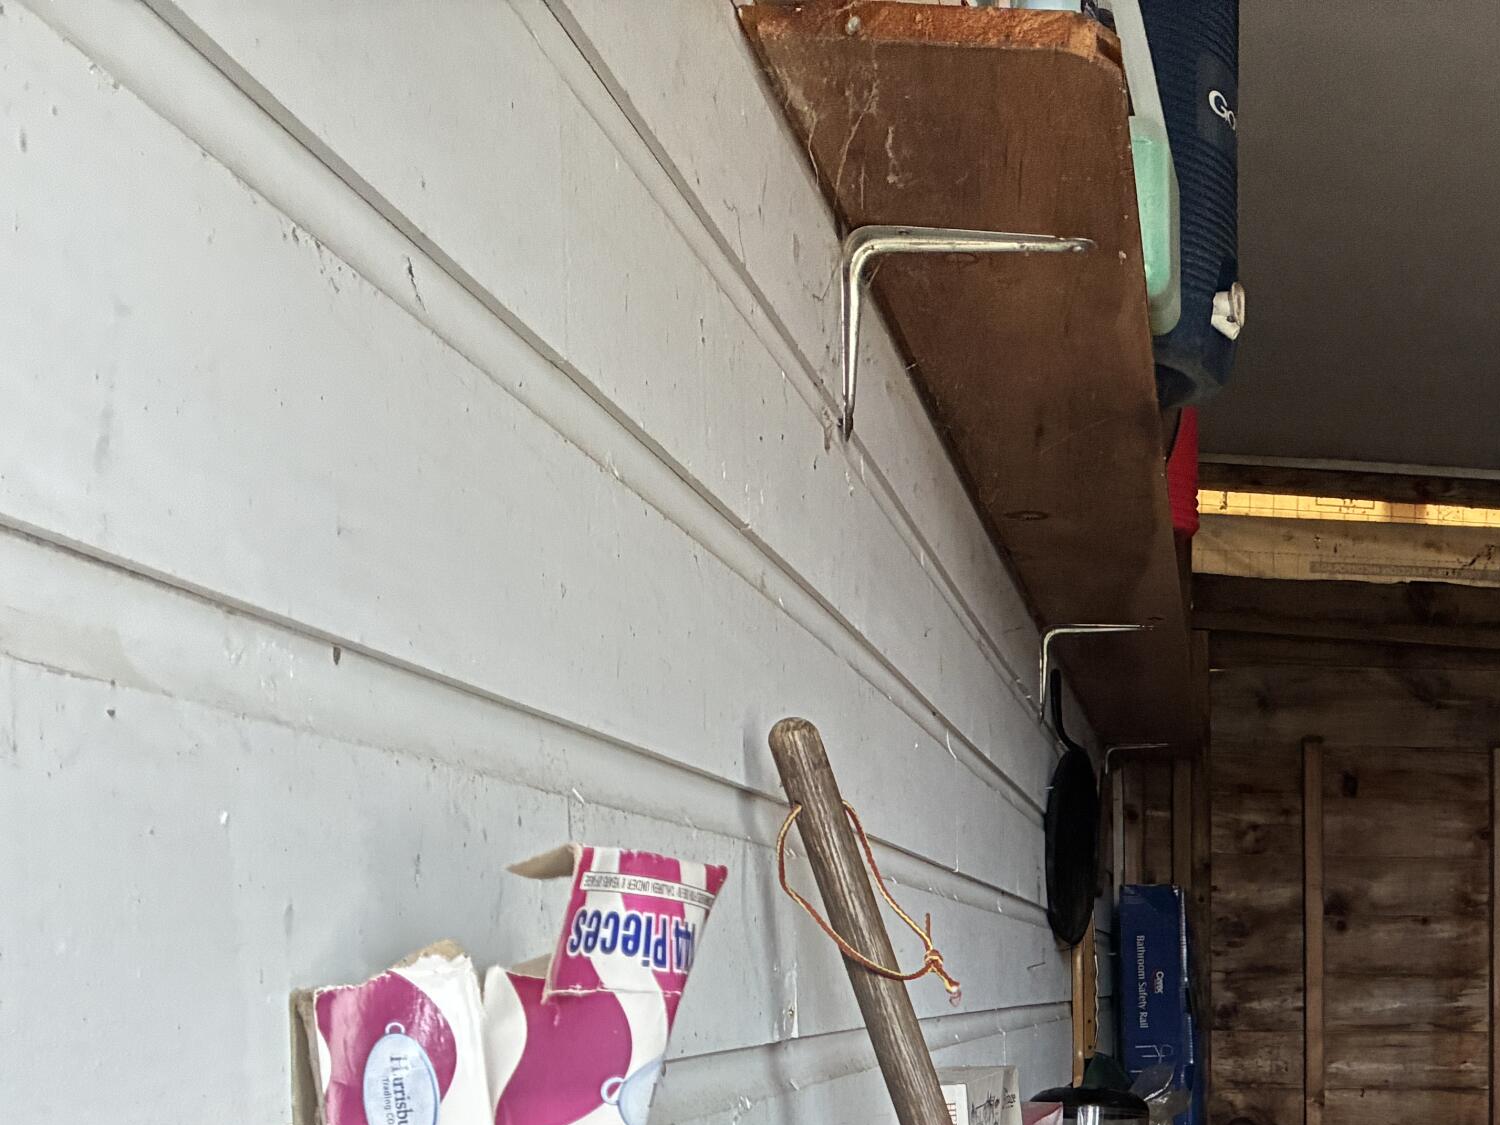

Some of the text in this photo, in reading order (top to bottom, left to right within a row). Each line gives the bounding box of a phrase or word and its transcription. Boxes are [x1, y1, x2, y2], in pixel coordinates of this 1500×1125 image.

[568, 908, 668, 970] Pieces
[1136, 935, 1149, 1029] Bathroom Safety Rail
[383, 1078, 393, 1111] Trading
